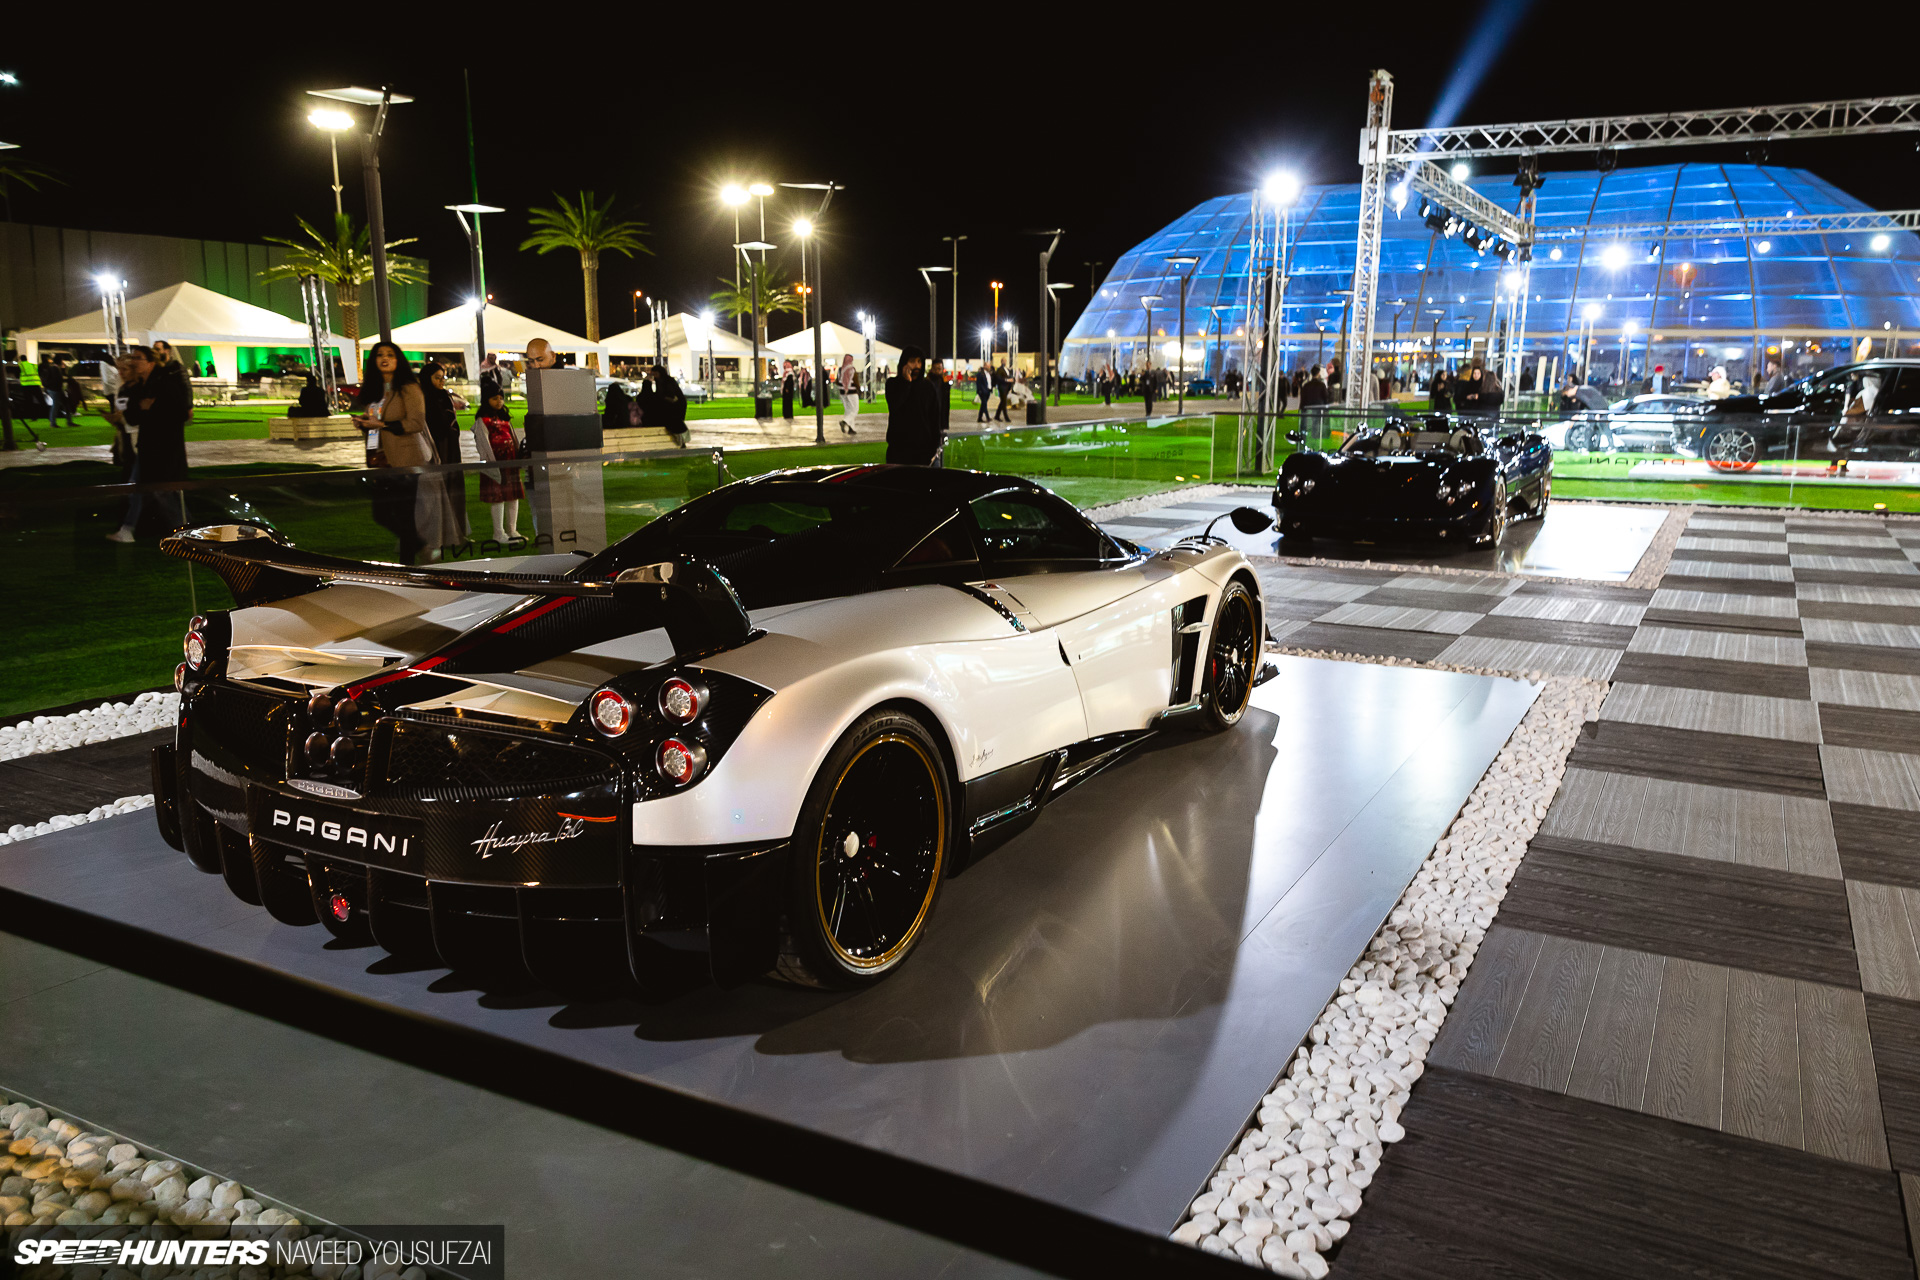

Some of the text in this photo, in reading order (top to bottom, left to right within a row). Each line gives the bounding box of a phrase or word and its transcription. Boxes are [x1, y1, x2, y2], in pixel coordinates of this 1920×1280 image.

[297, 781, 349, 799] PAGANI
[272, 809, 409, 857] PAGANI
[470, 820, 556, 860] Huayra
